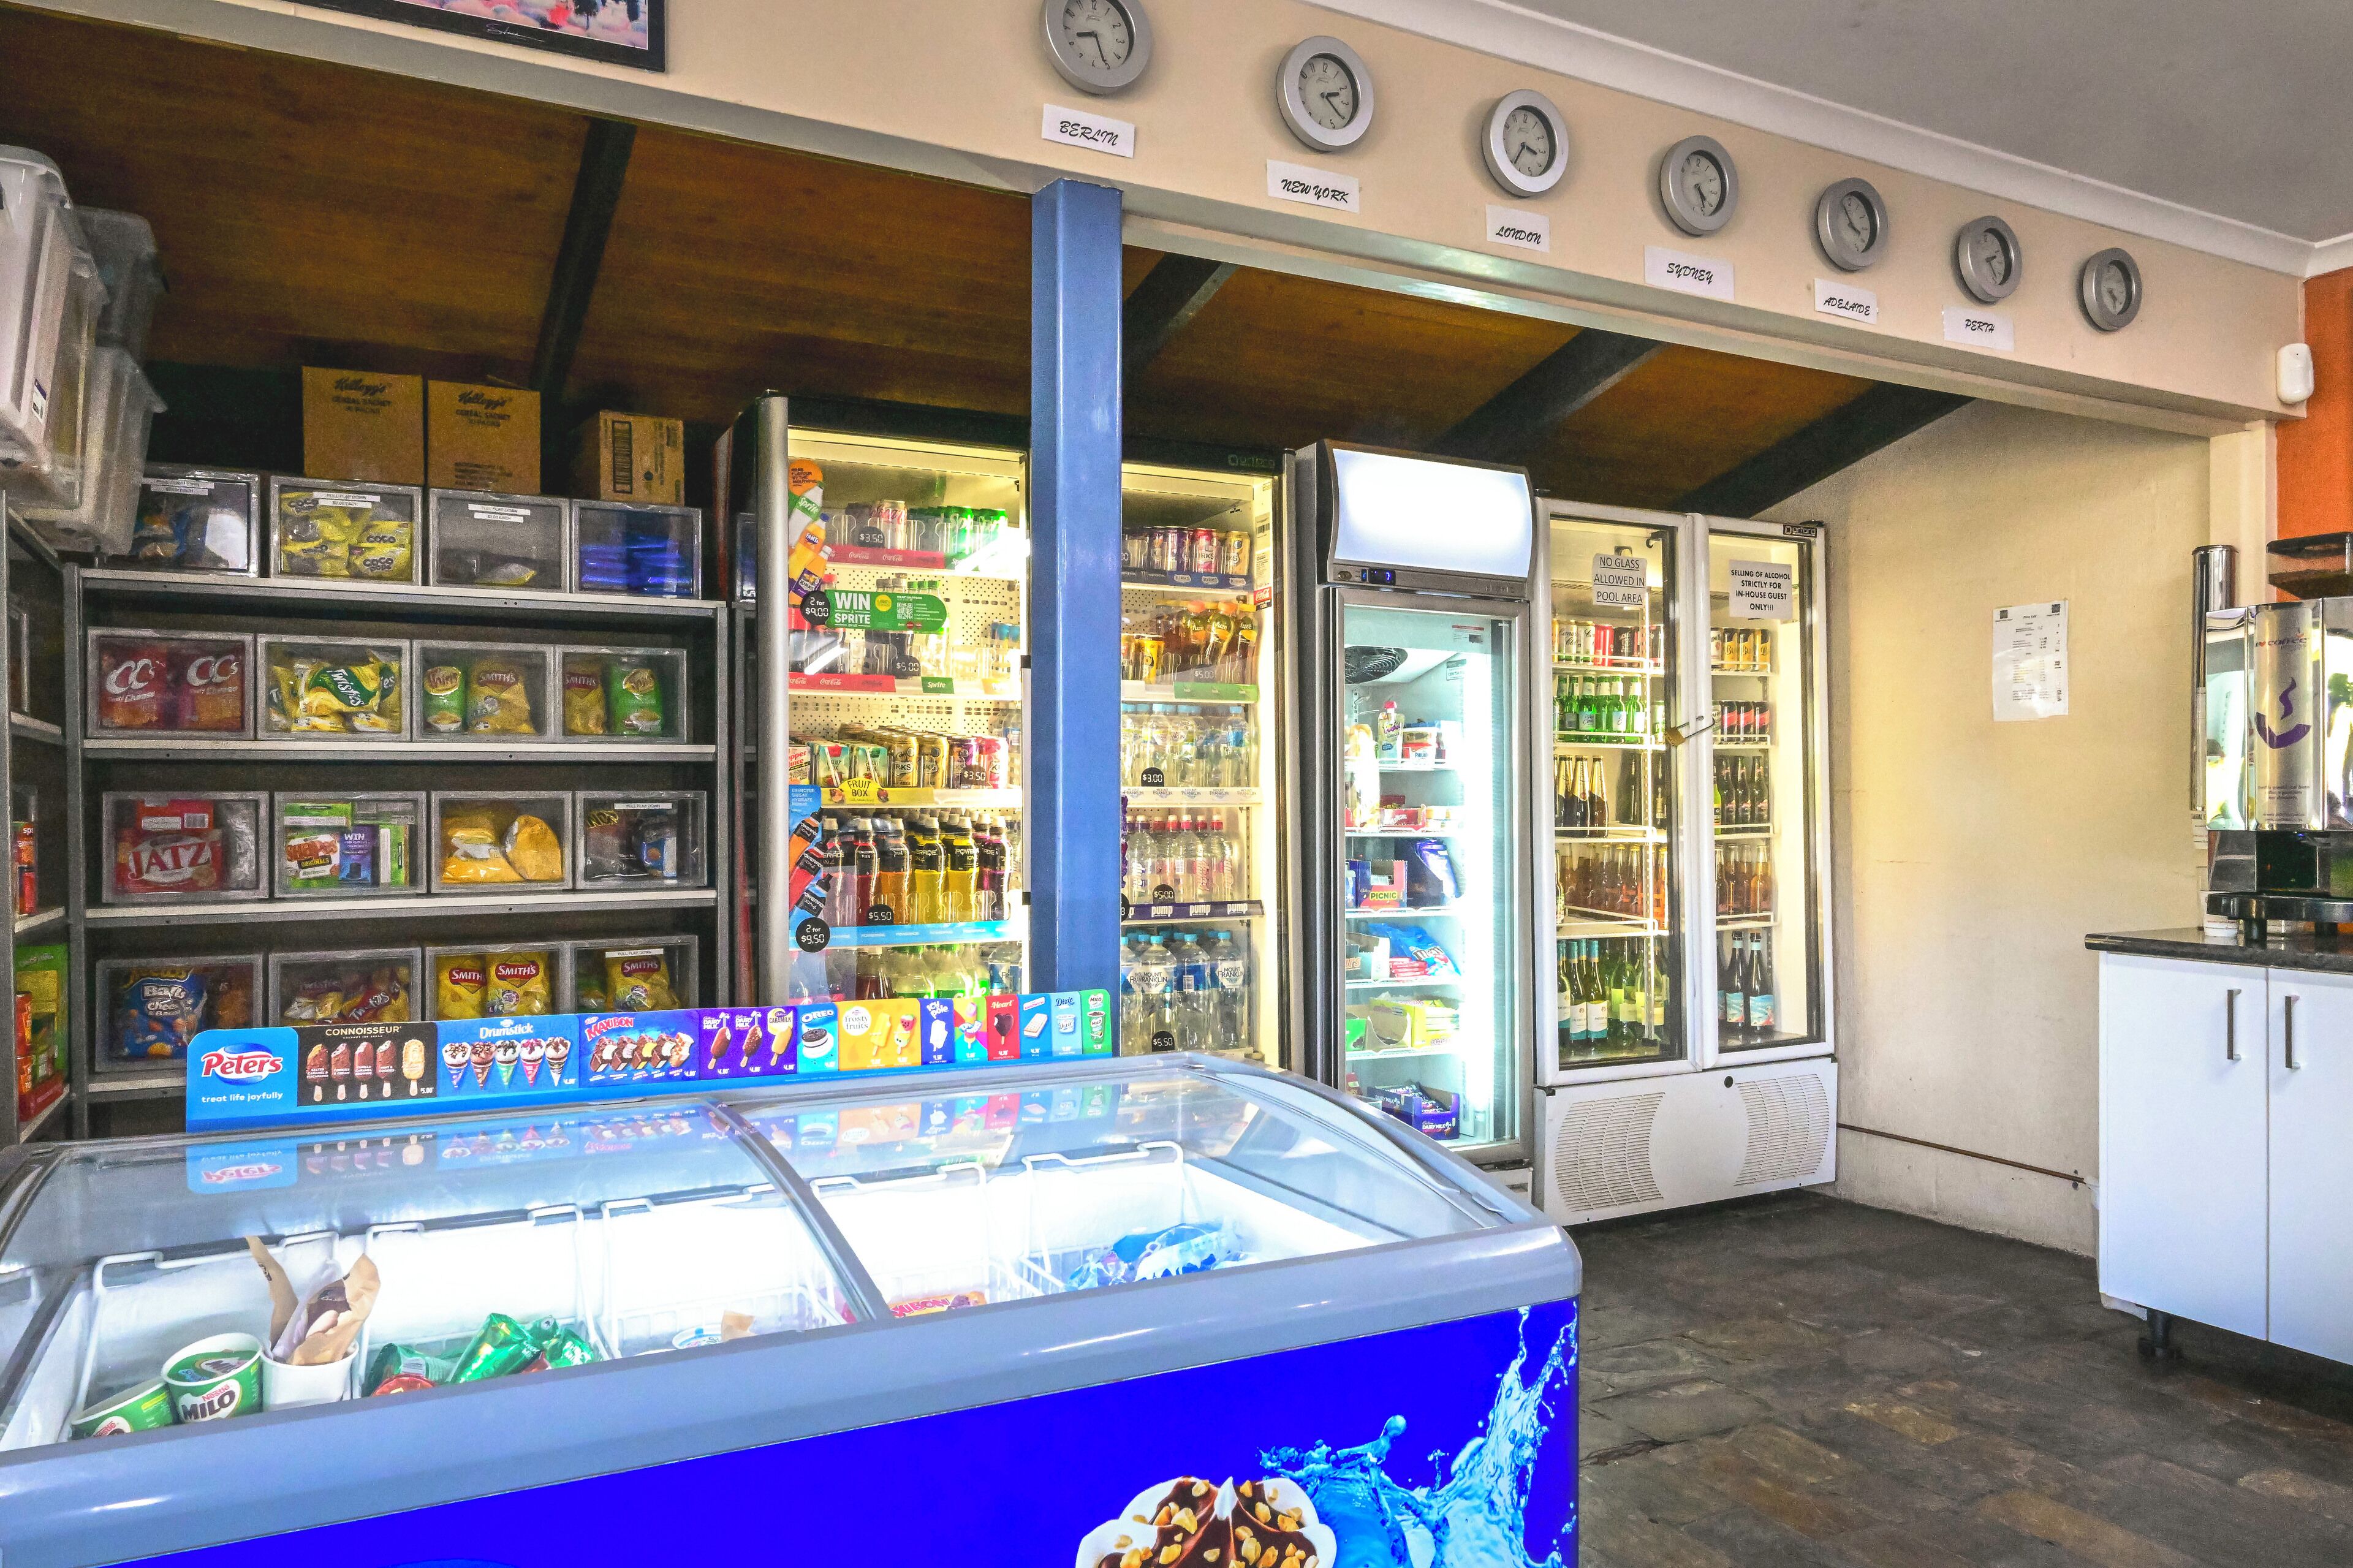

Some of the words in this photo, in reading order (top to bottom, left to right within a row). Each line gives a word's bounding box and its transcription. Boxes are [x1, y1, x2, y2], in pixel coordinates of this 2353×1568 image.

[1059, 120, 1119, 146] BERLIN
[1281, 179, 1311, 195] NEW
[1313, 185, 1349, 203] YORK
[1496, 225, 1543, 245] LONDON
[1667, 262, 1714, 285] SYDNEY
[1824, 296, 1871, 317] ADELAIDE
[1965, 319, 1996, 335] PERTH
[797, 498, 819, 514] Sprite
[806, 533, 819, 544] FANTA
[860, 533, 883, 543] $3.50
[1600, 557, 1612, 566] NO
[1615, 558, 1639, 569] GLASS
[1385, 572, 1391, 581] 7
[1594, 574, 1634, 585] ALLOWED
[1637, 577, 1645, 586] IN
[1597, 591, 1619, 601] POOL
[1621, 593, 1643, 603] AREA
[1736, 590, 1767, 599] IN-HOUSE
[835, 592, 871, 611] WIN
[835, 613, 871, 624] SPRITE
[964, 771, 986, 781] $3.50
[1142, 774, 1162, 782] $3.00
[847, 780, 871, 789] FRUIT
[128, 843, 211, 880] JATZ
[1370, 892, 1397, 901] PICNIC
[1151, 906, 1173, 917] pump
[1189, 904, 1211, 916] pump
[1227, 903, 1248, 914] pump
[868, 911, 892, 920] $5.50
[801, 934, 825, 944] $9.50
[498, 964, 537, 975] SMITH'S
[990, 1000, 1012, 1009] Heart
[1055, 997, 1074, 1006] Dixie
[801, 1010, 834, 1023] OREO
[844, 1014, 868, 1023] frosty
[325, 1026, 400, 1036] CONNOISSEUR
[480, 1023, 534, 1039] Drumstick
[585, 1017, 634, 1041] MAXIBON
[846, 1021, 868, 1030] fruits
[1153, 1038, 1173, 1047] $5.50
[202, 1052, 282, 1077] Peters
[248, 1091, 284, 1102] joyfully
[891, 1298, 950, 1317] XIBON
[202, 1385, 230, 1401] Nestlé
[181, 1390, 235, 1420] MILO
